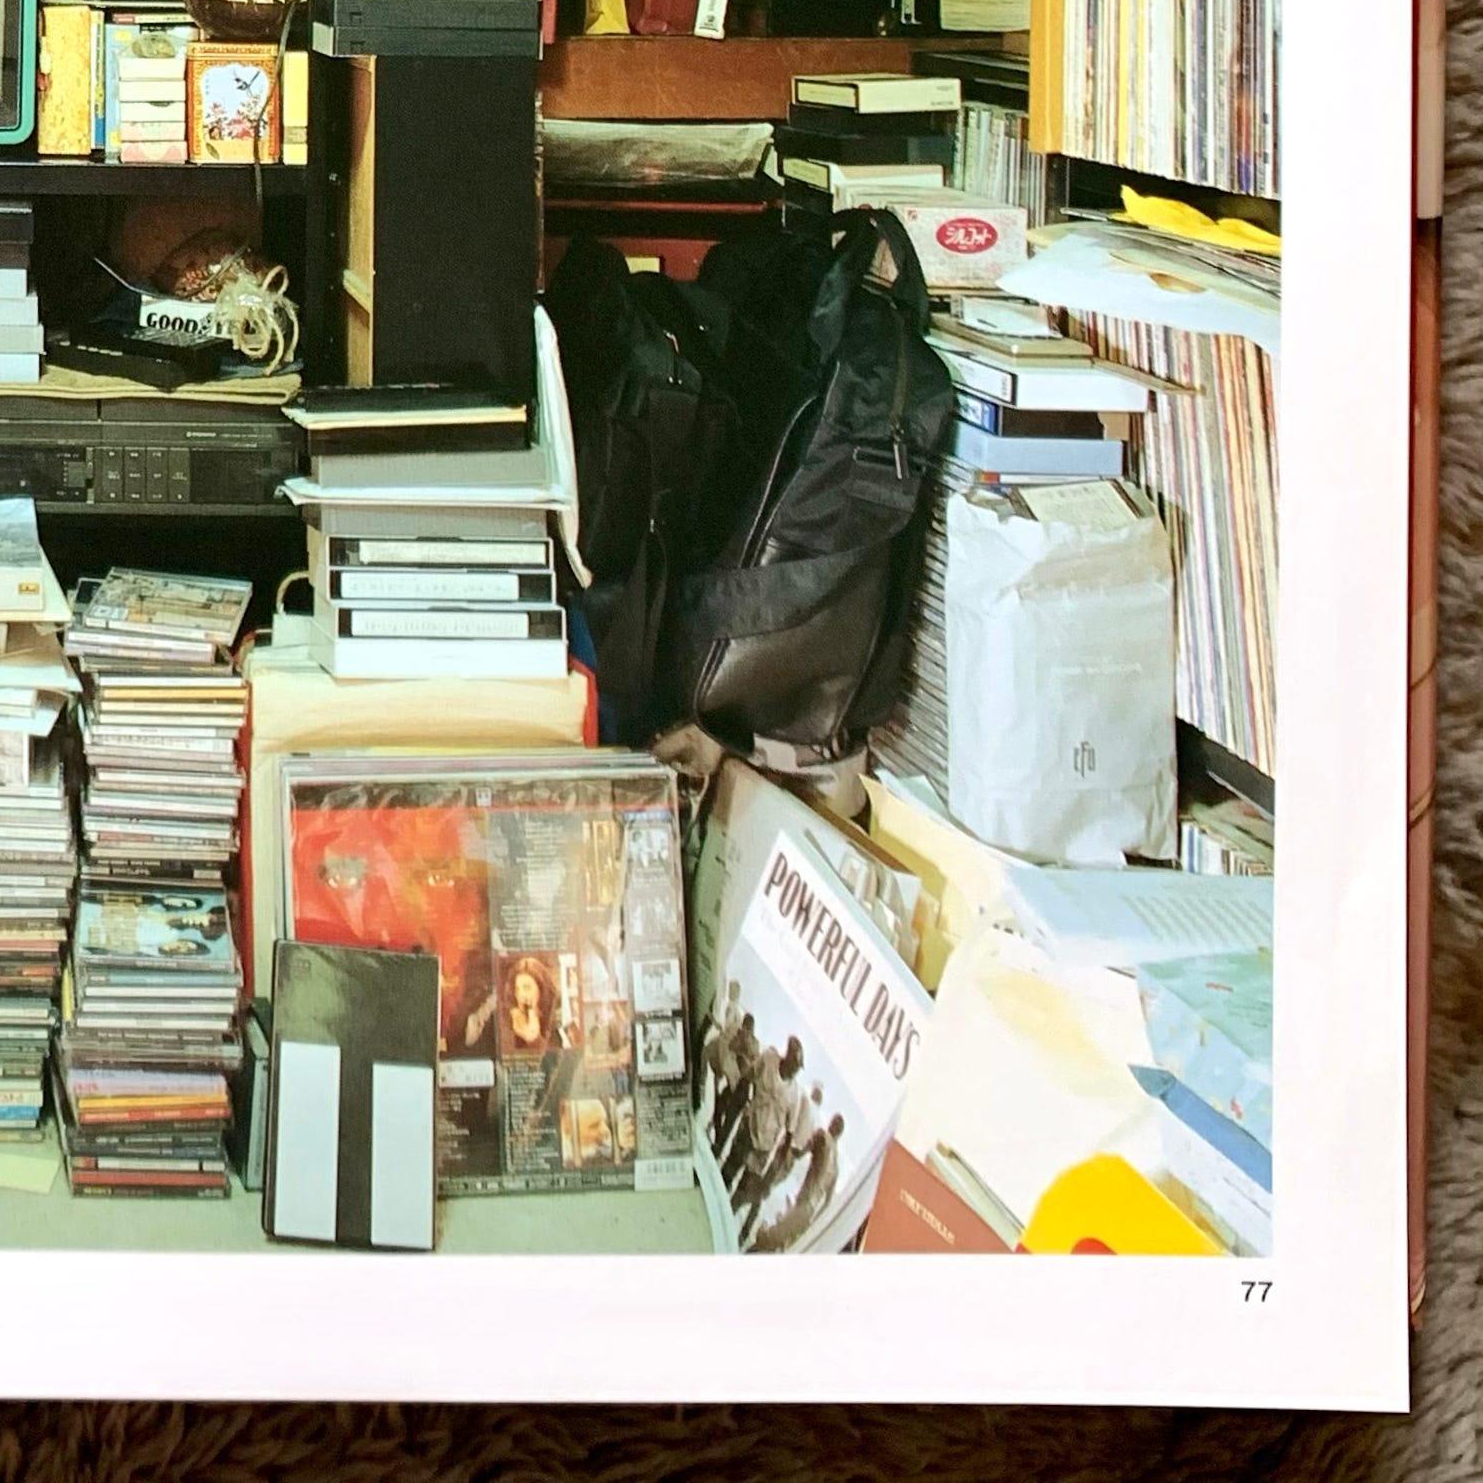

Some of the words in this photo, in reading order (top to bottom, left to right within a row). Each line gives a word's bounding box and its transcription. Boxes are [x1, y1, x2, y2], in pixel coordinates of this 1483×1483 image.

[764, 851, 872, 1017] POWERFUL
[863, 981, 922, 1081] DAYS
[1240, 1280, 1274, 1303] 77
